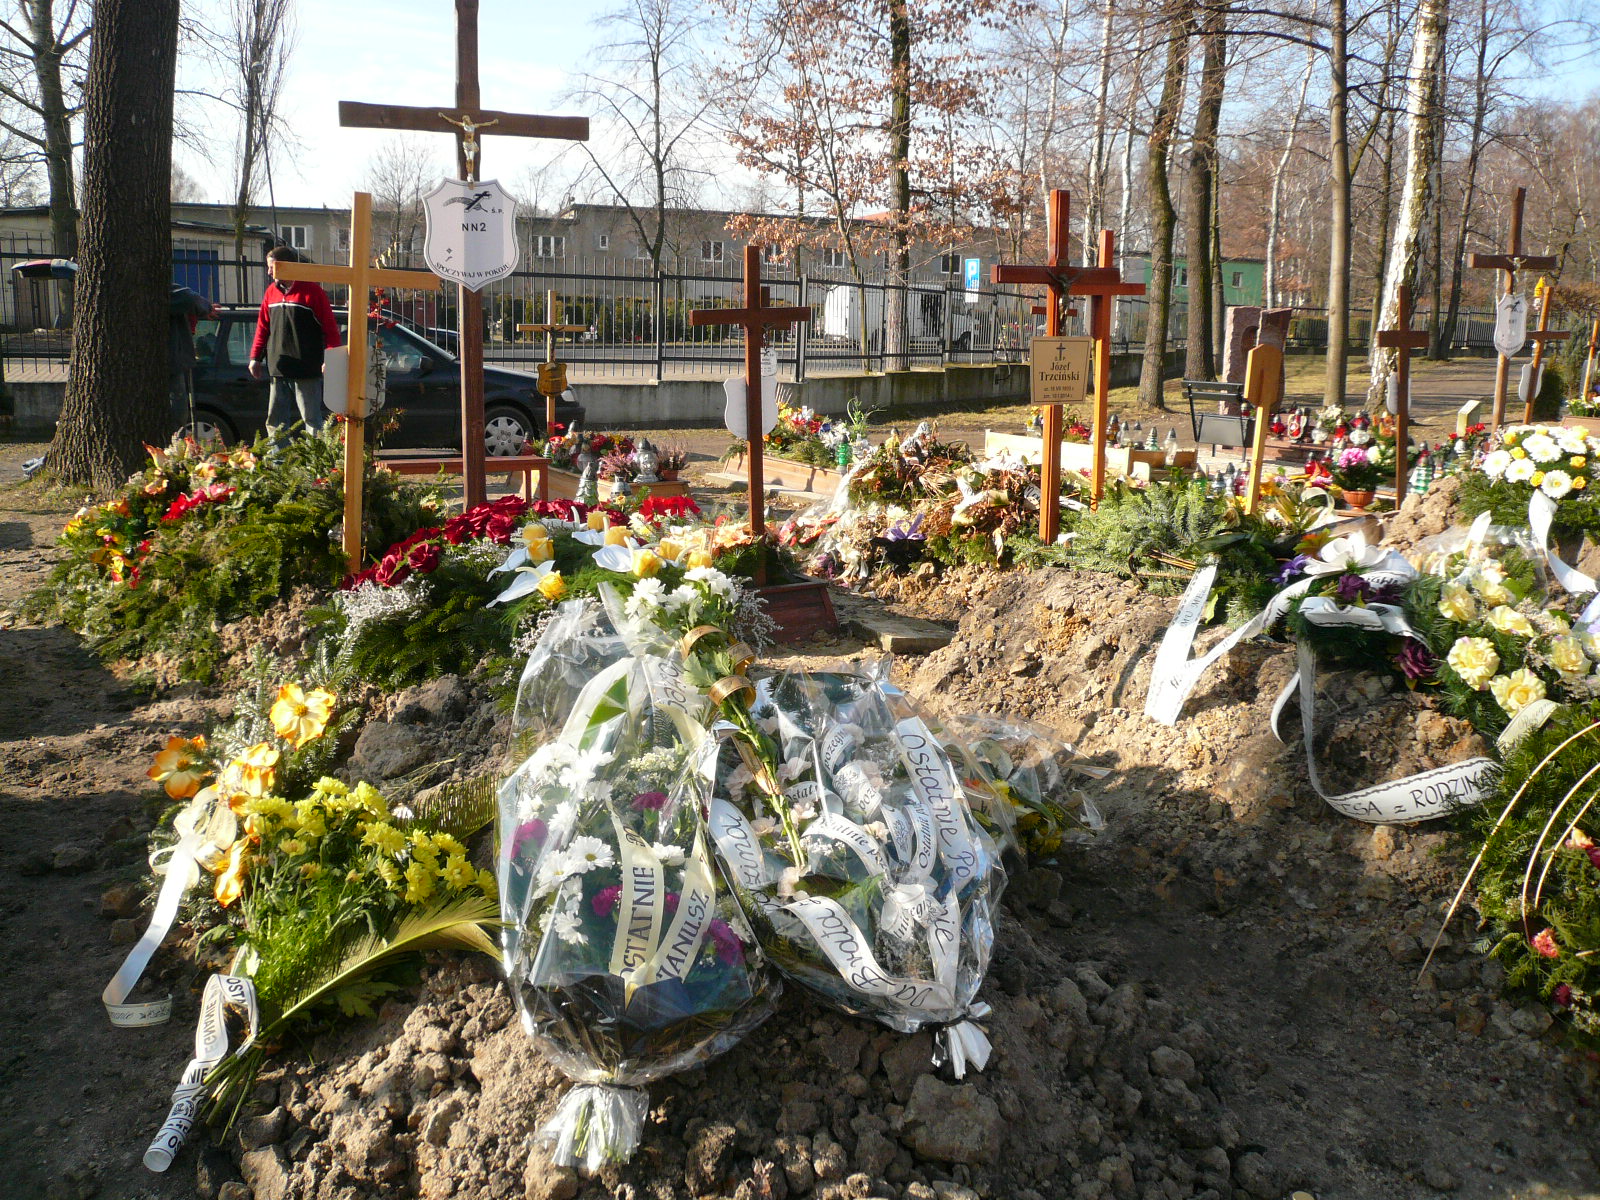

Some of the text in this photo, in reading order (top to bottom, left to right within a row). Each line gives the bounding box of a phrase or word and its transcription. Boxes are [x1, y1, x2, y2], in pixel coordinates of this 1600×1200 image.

[461, 222, 487, 232] NN2
[436, 262, 475, 278] SPOCZYWAJ
[484, 263, 509, 277] POKOJU
[967, 261, 977, 281] P
[1050, 361, 1071, 371] Józef
[1039, 371, 1080, 381] Trzciński
[901, 734, 958, 848] Ostatnie
